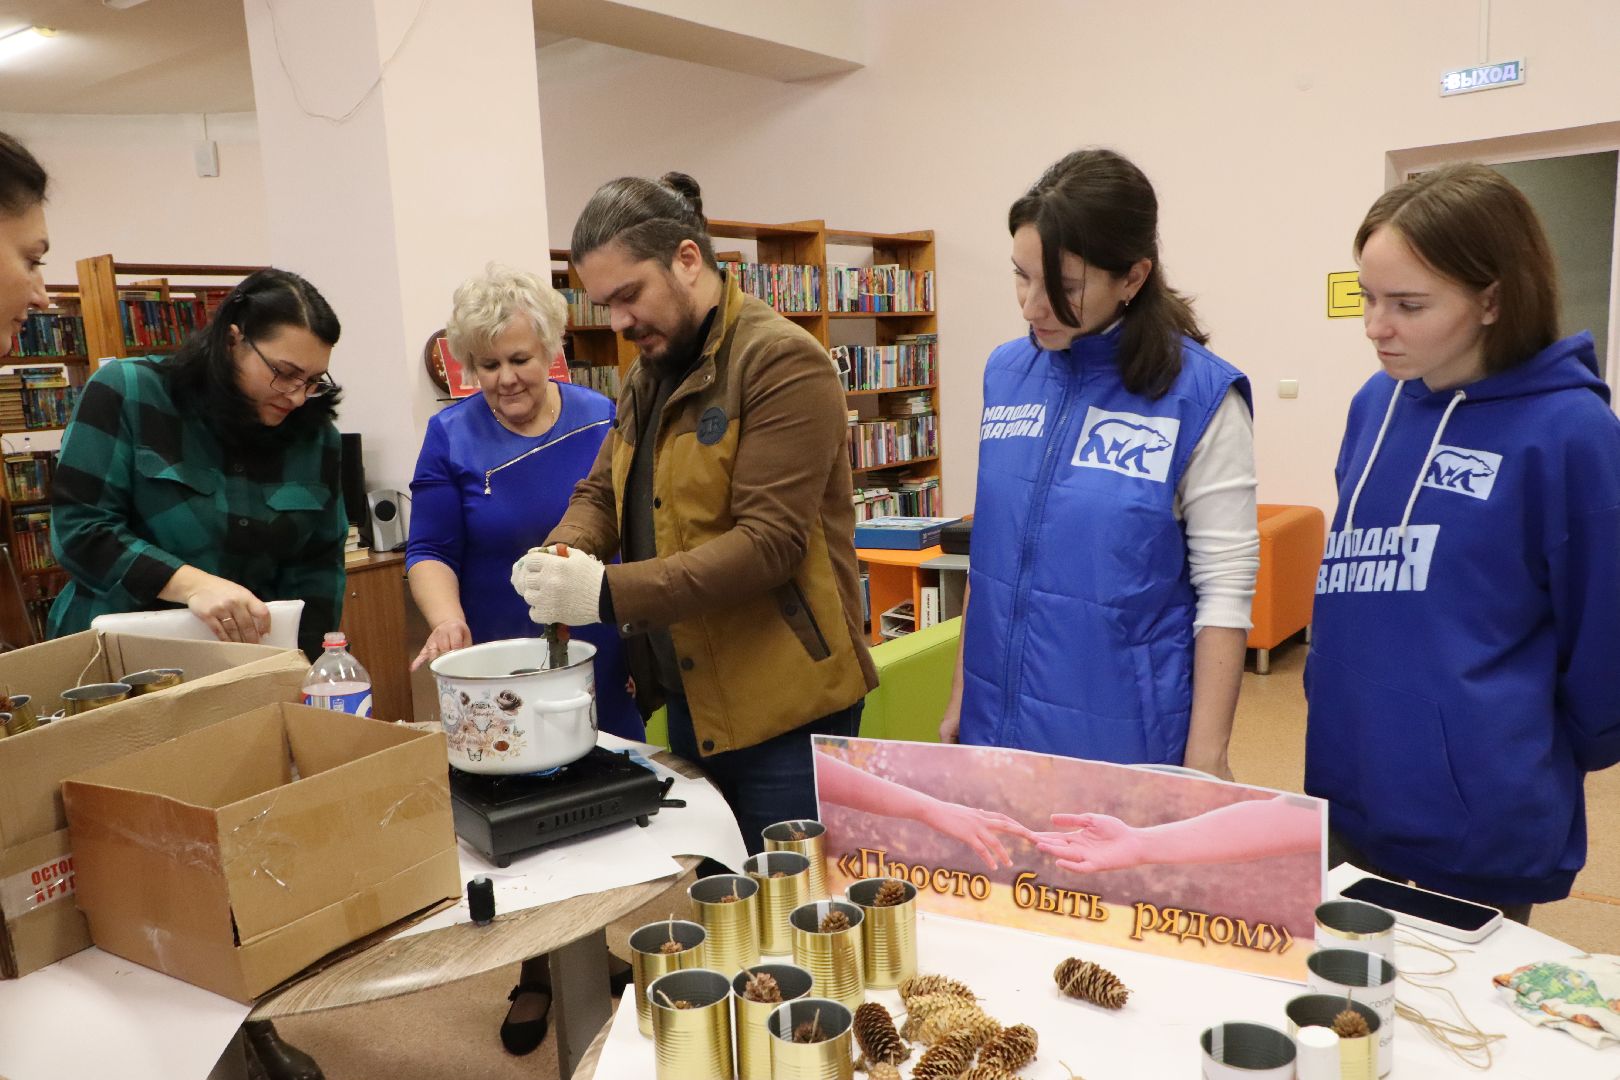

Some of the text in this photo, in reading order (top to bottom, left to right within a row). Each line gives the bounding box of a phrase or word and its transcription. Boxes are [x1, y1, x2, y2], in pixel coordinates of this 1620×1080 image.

[1446, 63, 1517, 90] ВЫХОД
[838, 847, 1295, 954] «Просто быть рядом»
